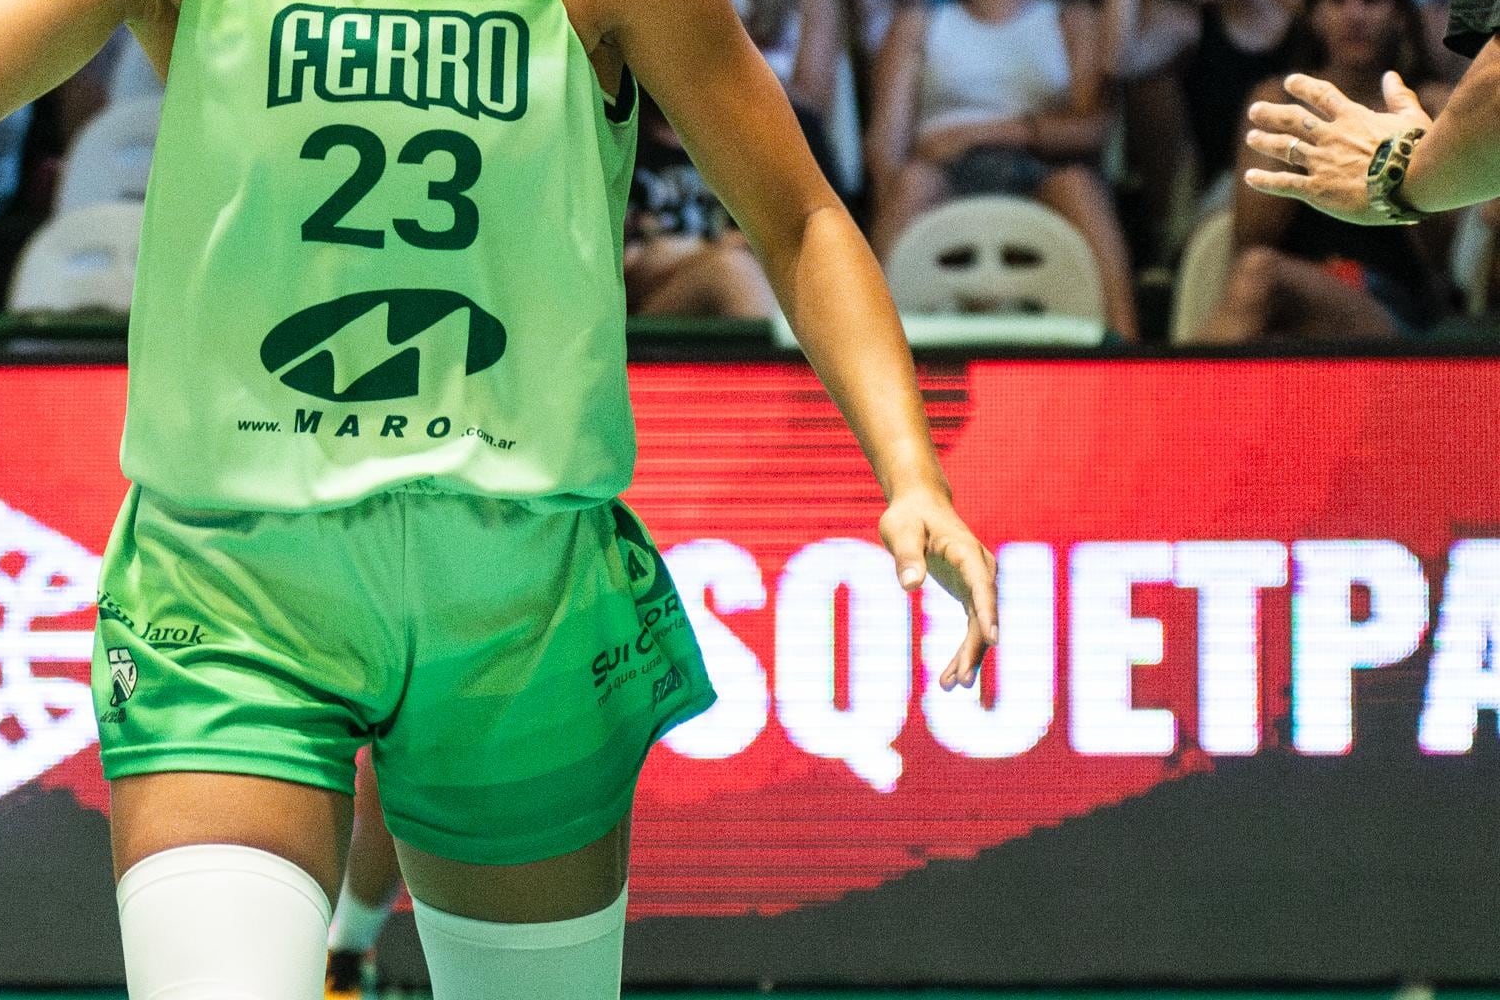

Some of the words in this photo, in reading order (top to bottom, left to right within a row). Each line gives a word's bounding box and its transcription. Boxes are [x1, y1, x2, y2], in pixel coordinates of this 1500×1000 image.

[268, 3, 529, 121] FERRO
[299, 124, 482, 250] 23
[294, 409, 451, 438] MARO
